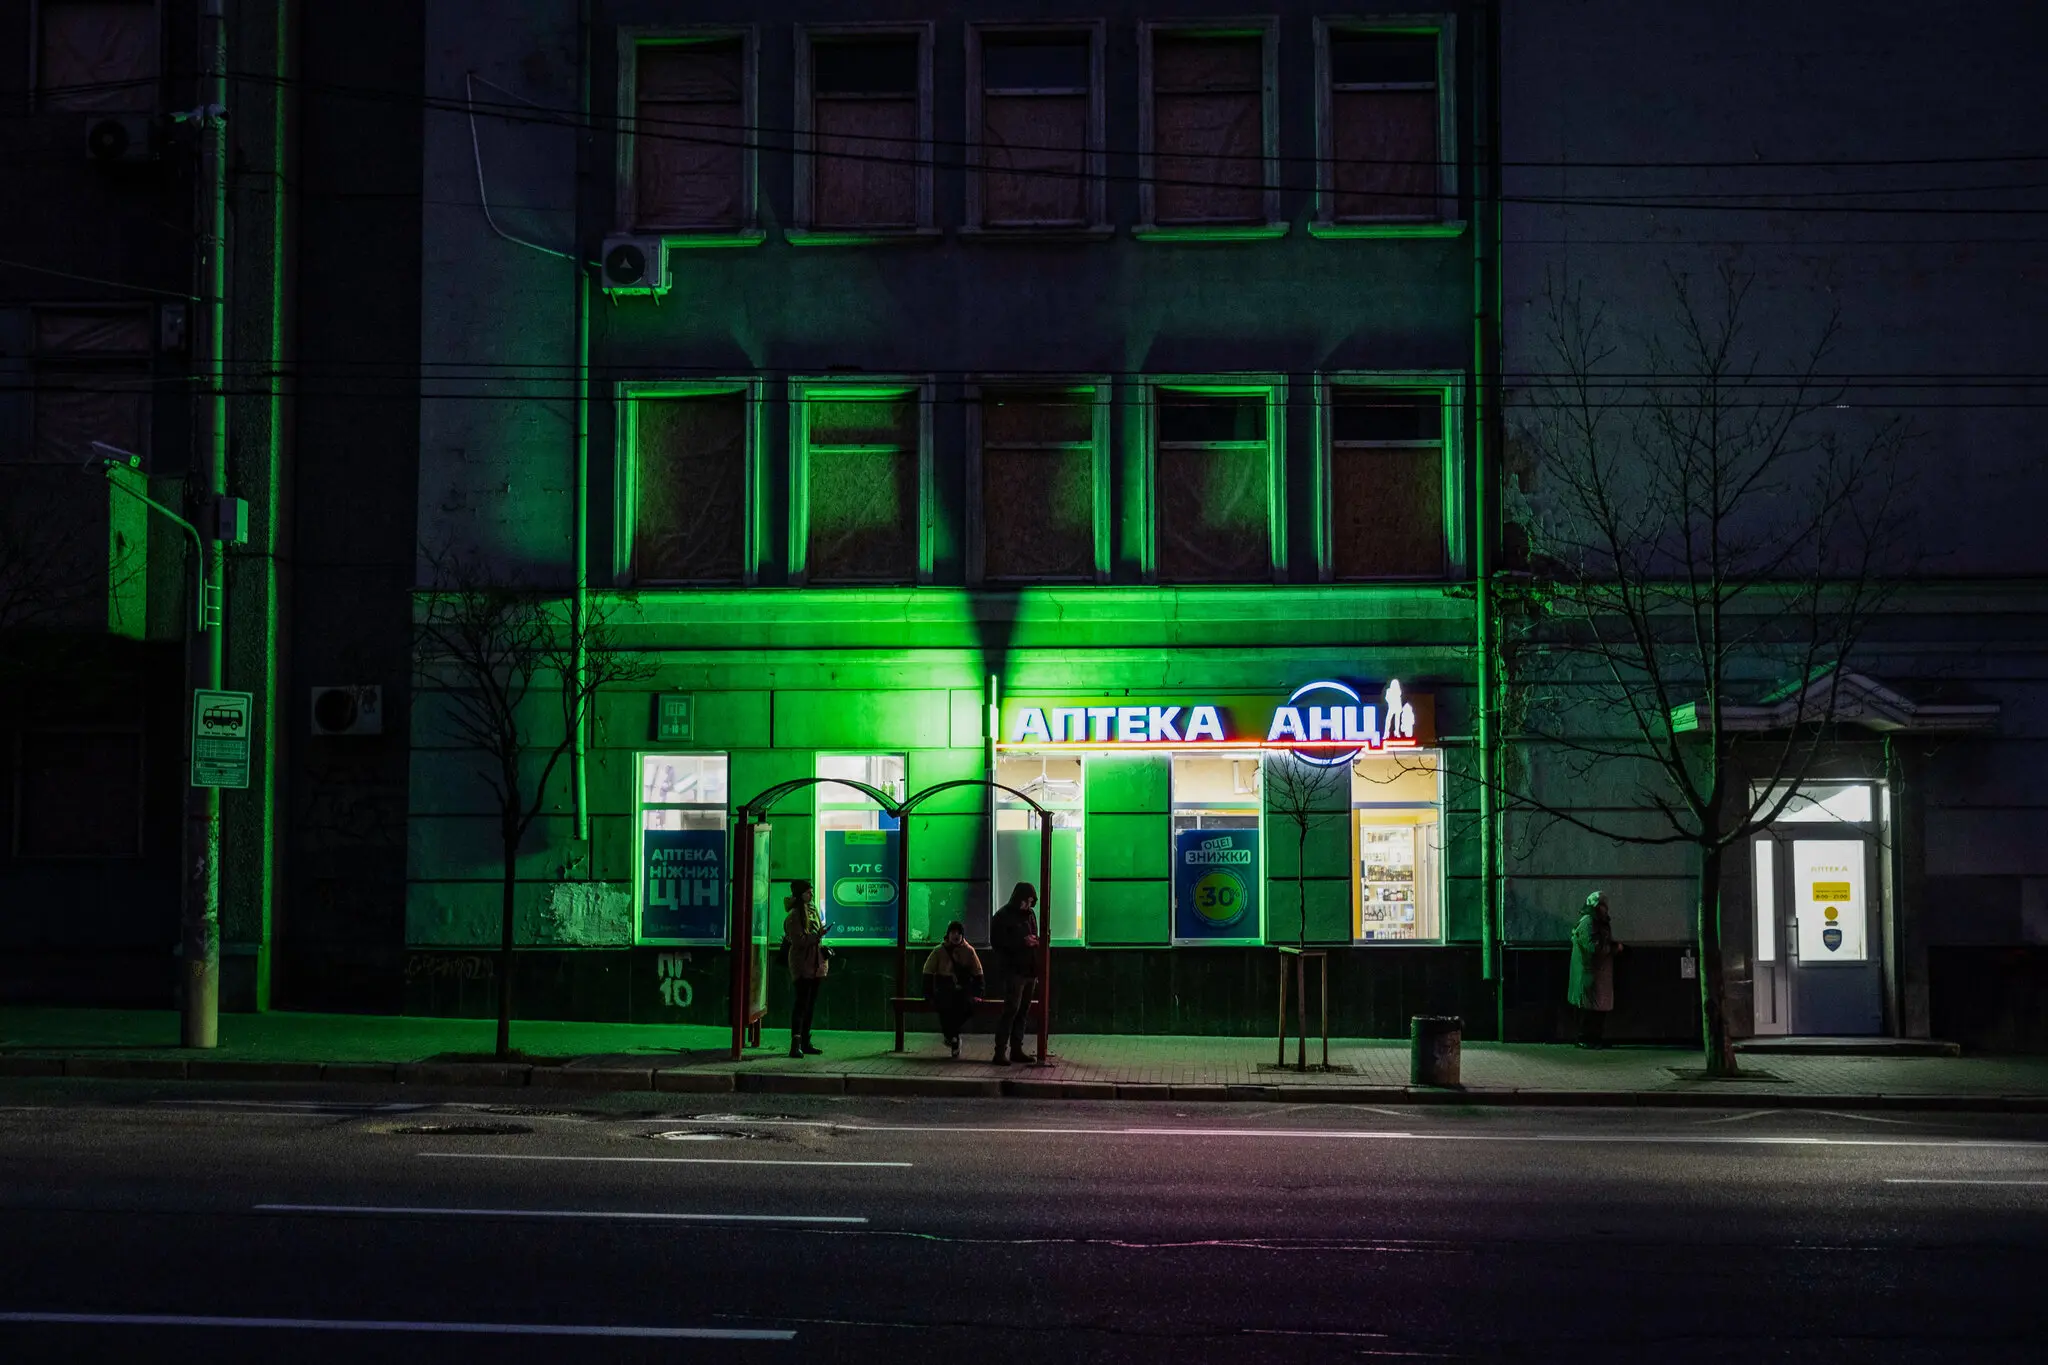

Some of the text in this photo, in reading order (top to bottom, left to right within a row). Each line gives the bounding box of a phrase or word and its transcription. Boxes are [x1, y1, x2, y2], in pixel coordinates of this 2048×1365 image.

[1012, 705, 1382, 747] АПТЕКА АНЦ
[1203, 838, 1231, 850] ОЦЕ!
[651, 848, 718, 861] АПТЕКА
[1188, 851, 1249, 863] ЗНИЖКИ
[848, 863, 883, 873] ТУТ Є
[649, 879, 720, 911] ЦІН
[659, 977, 693, 1008] 10
